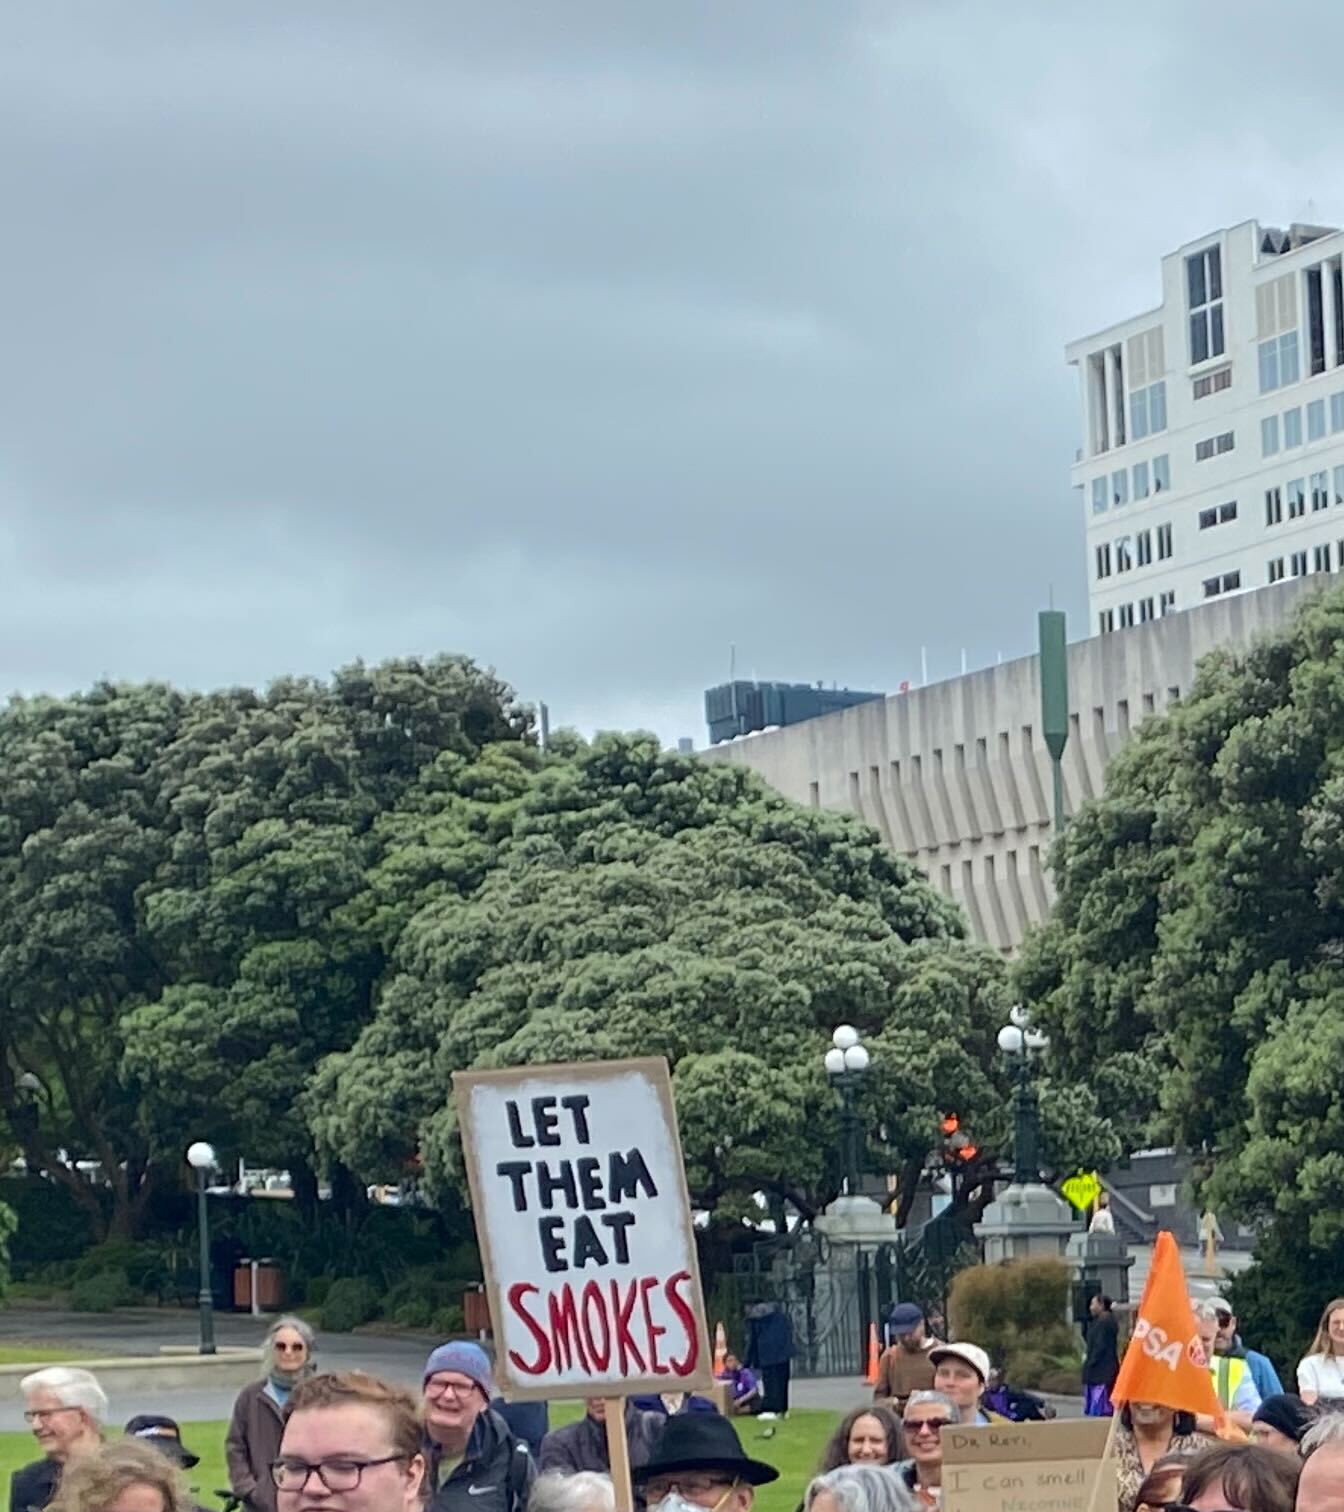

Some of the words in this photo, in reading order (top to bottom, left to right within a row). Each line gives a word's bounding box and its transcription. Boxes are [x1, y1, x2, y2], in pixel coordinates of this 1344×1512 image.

[505, 1094, 590, 1148] LET
[496, 1147, 659, 1213] THEM
[538, 1211, 636, 1273] EAT
[507, 1270, 699, 1378] SMOKES
[1132, 1316, 1184, 1372] PSA
[947, 1468, 971, 1493] I
[1037, 1467, 1086, 1487] smell
